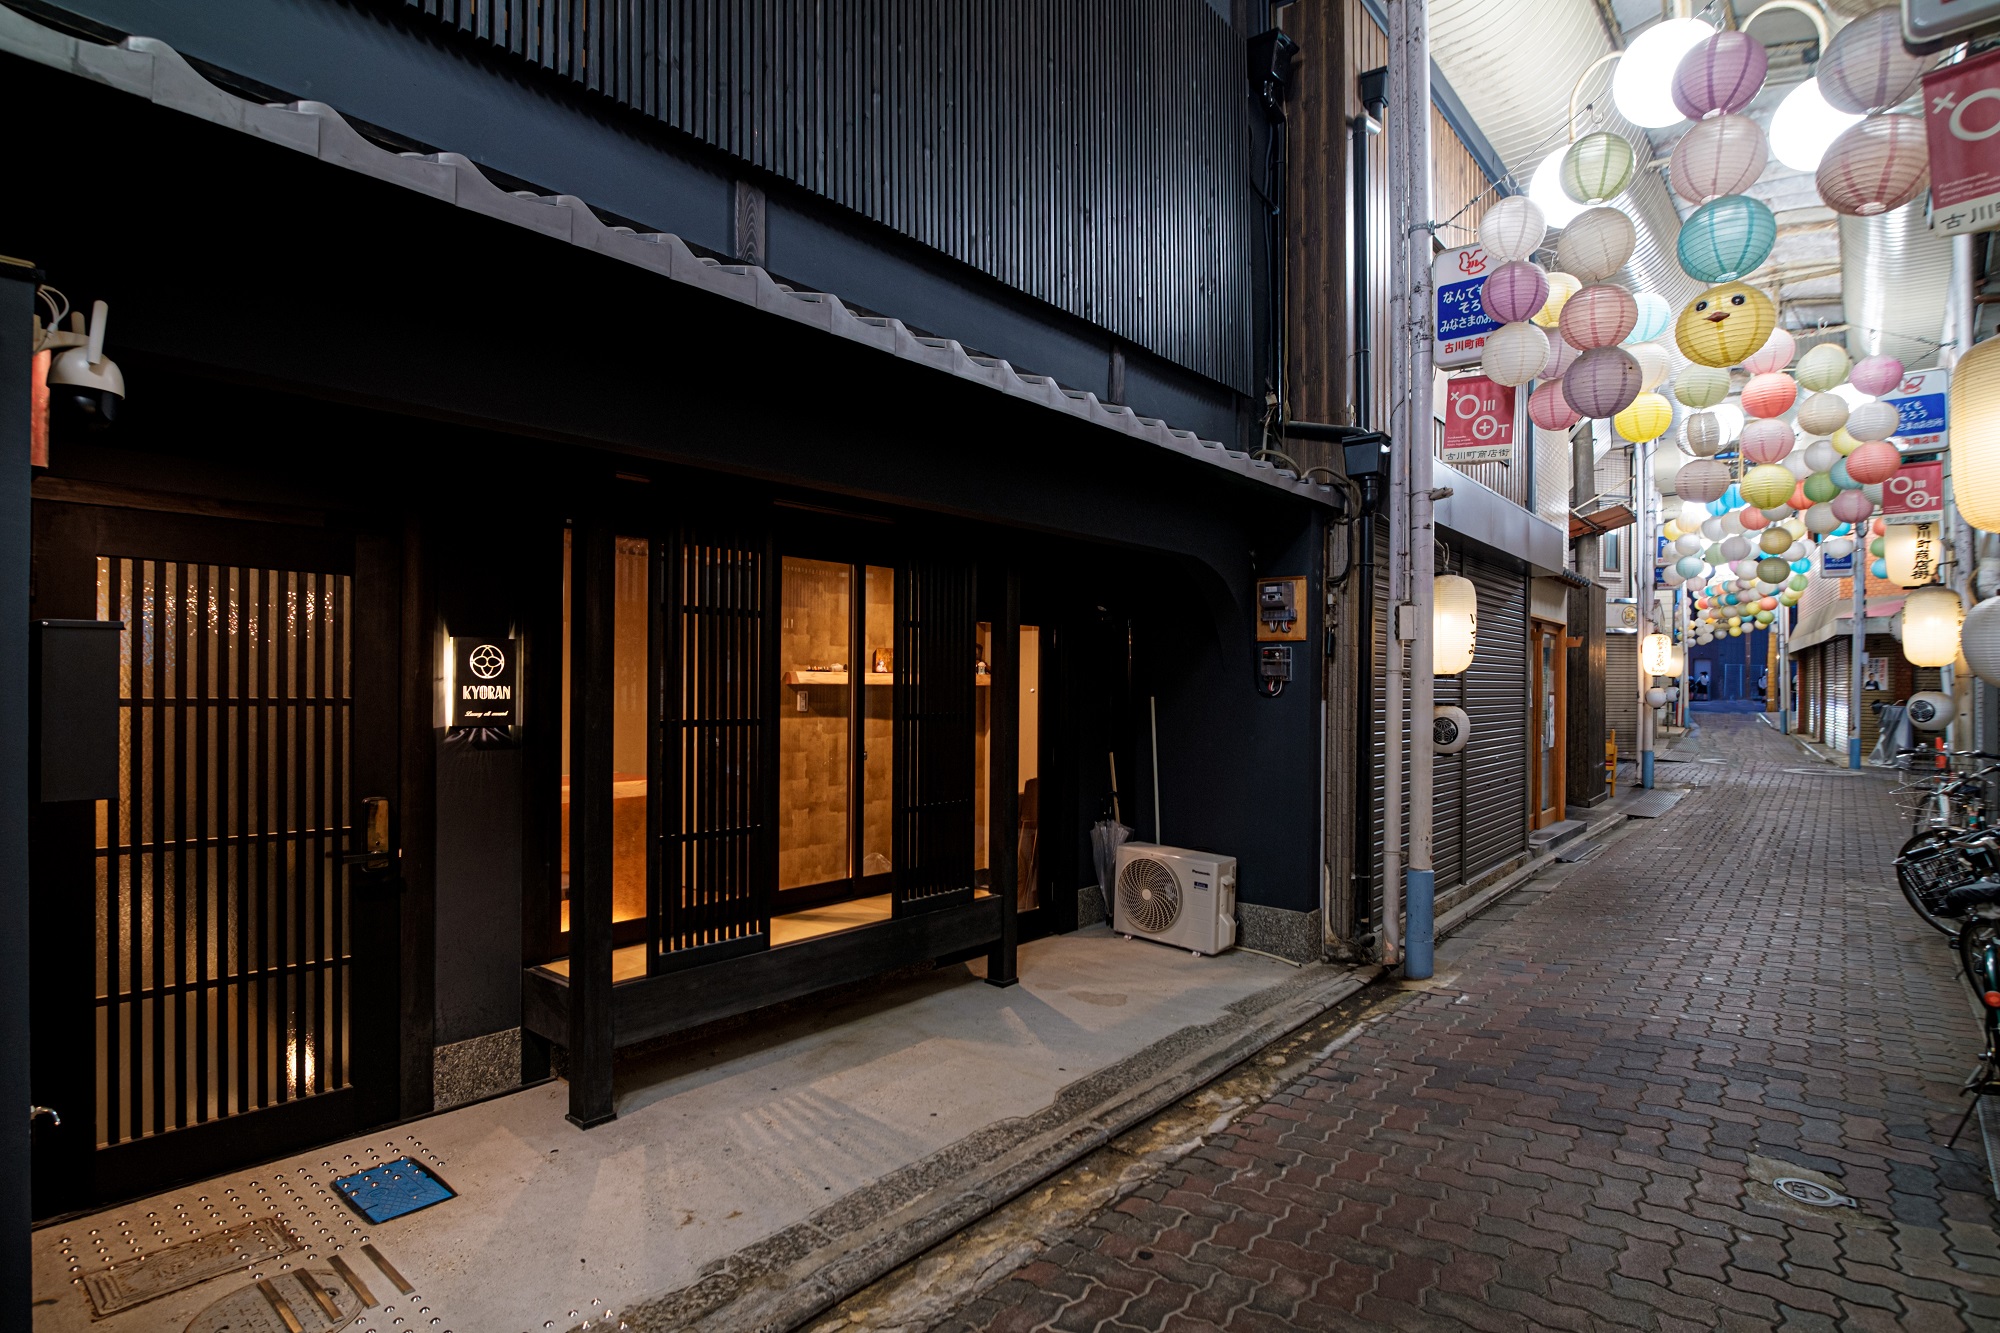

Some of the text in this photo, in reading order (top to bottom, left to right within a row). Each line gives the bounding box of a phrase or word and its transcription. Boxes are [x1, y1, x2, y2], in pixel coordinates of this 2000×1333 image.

[1445, 336, 1489, 354] 古川町商
[1446, 449, 1510, 460] 古川町商店街
[462, 685, 511, 700] KYORAN
